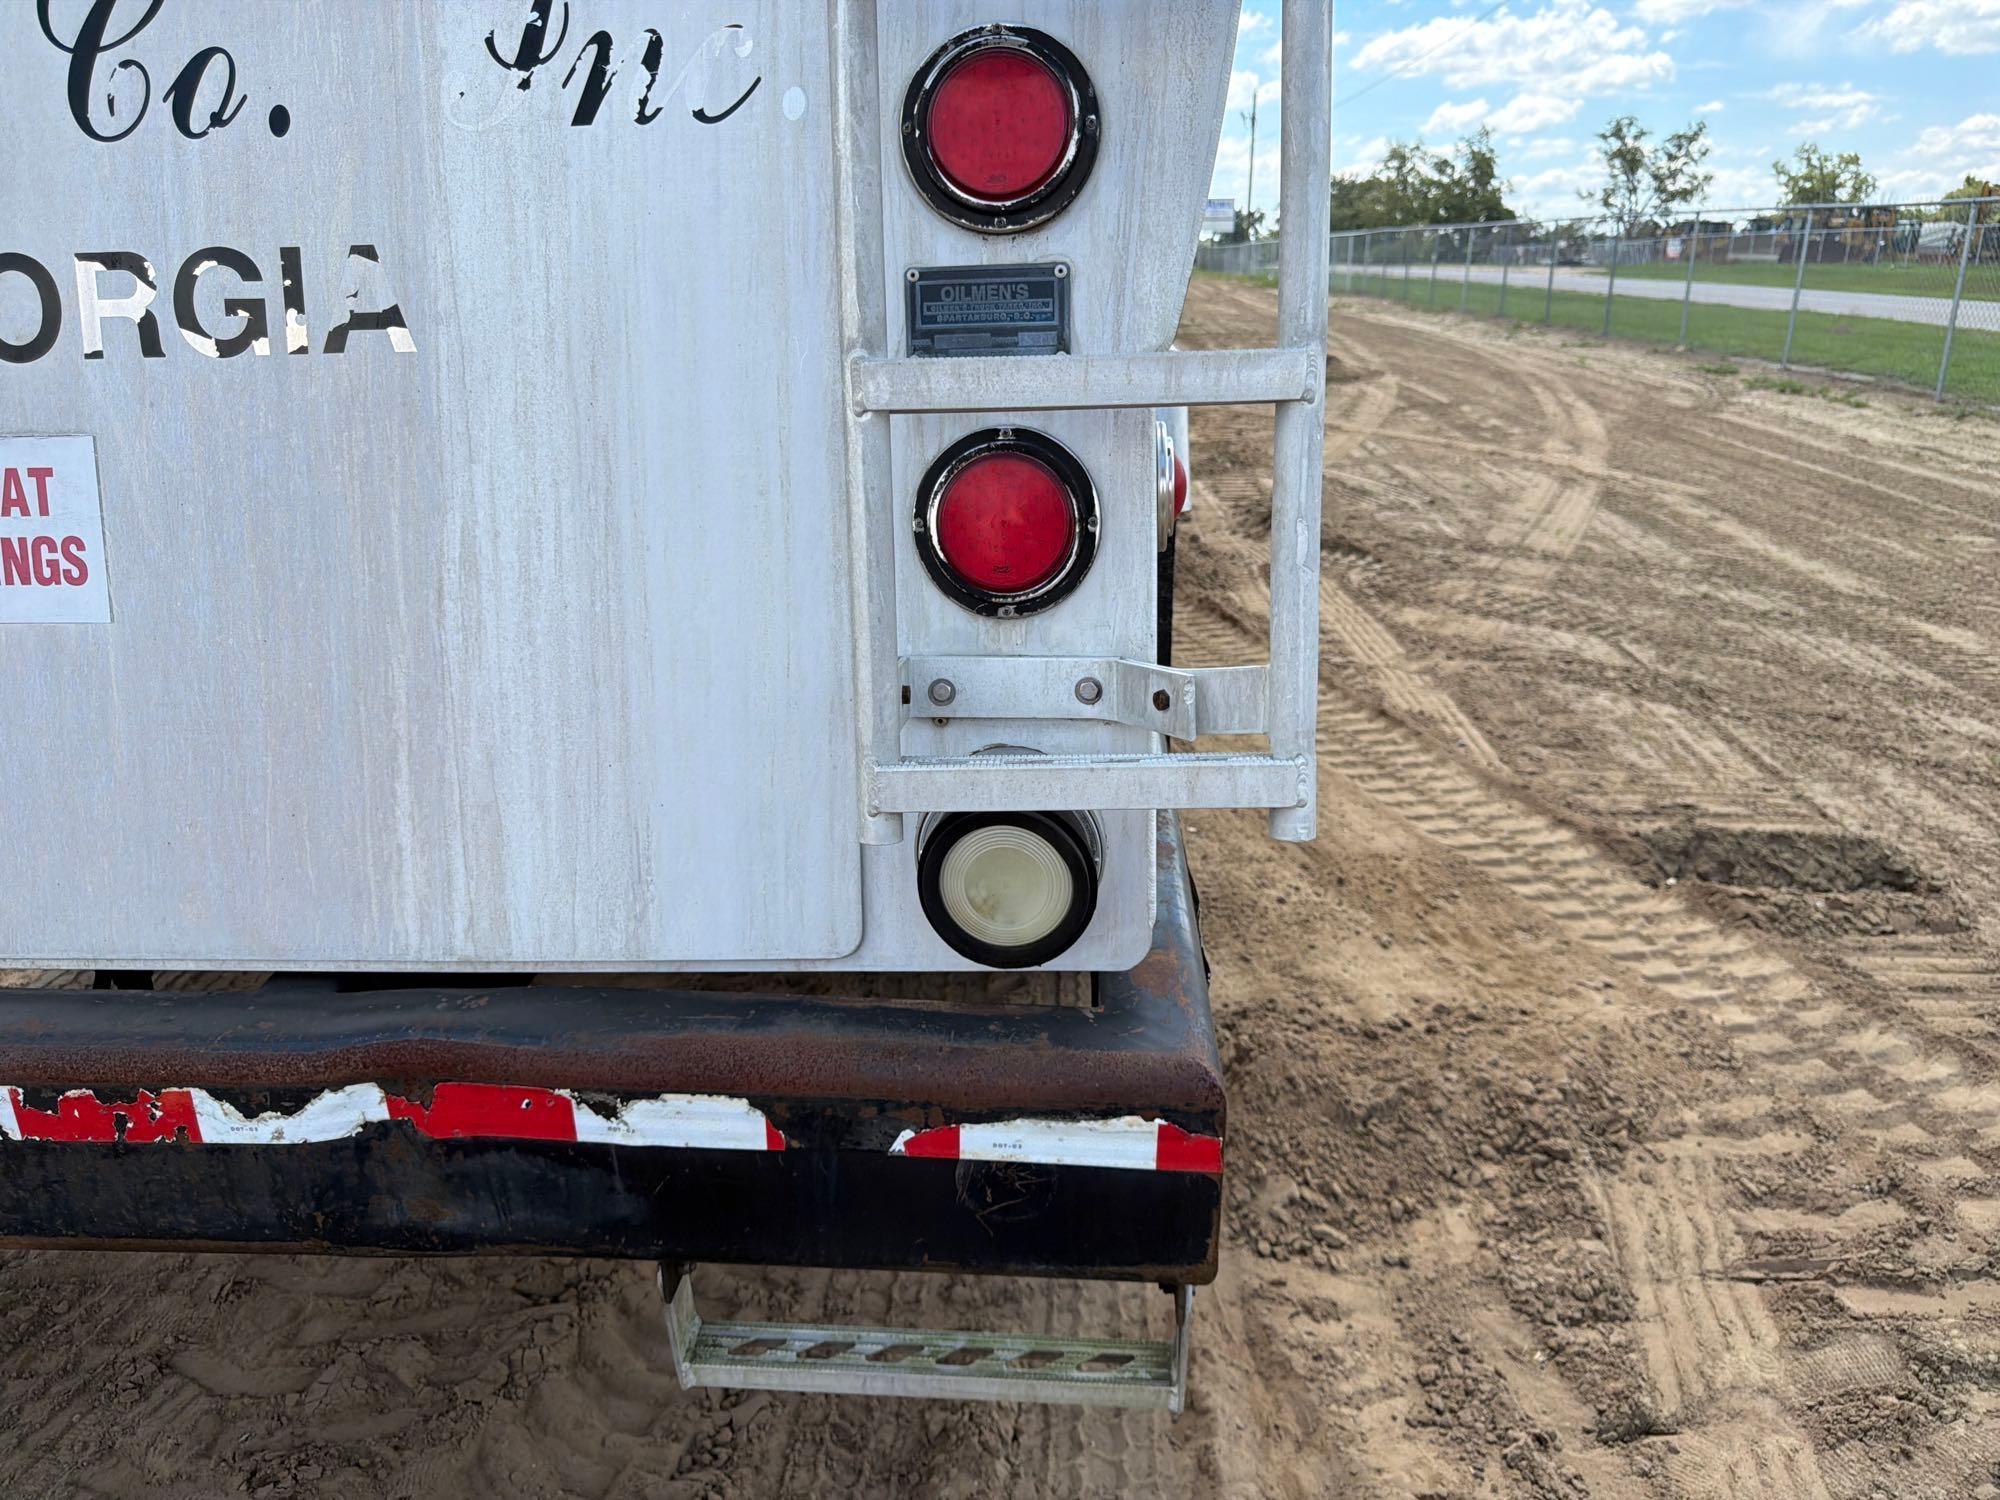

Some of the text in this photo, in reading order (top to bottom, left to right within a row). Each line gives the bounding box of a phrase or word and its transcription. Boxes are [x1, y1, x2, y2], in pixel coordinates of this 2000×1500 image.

[37, 0, 291, 142] Co.
[0, 244, 418, 363] ORGIA
[941, 283, 1030, 302] OILMEN'S
[0, 467, 54, 517] AT
